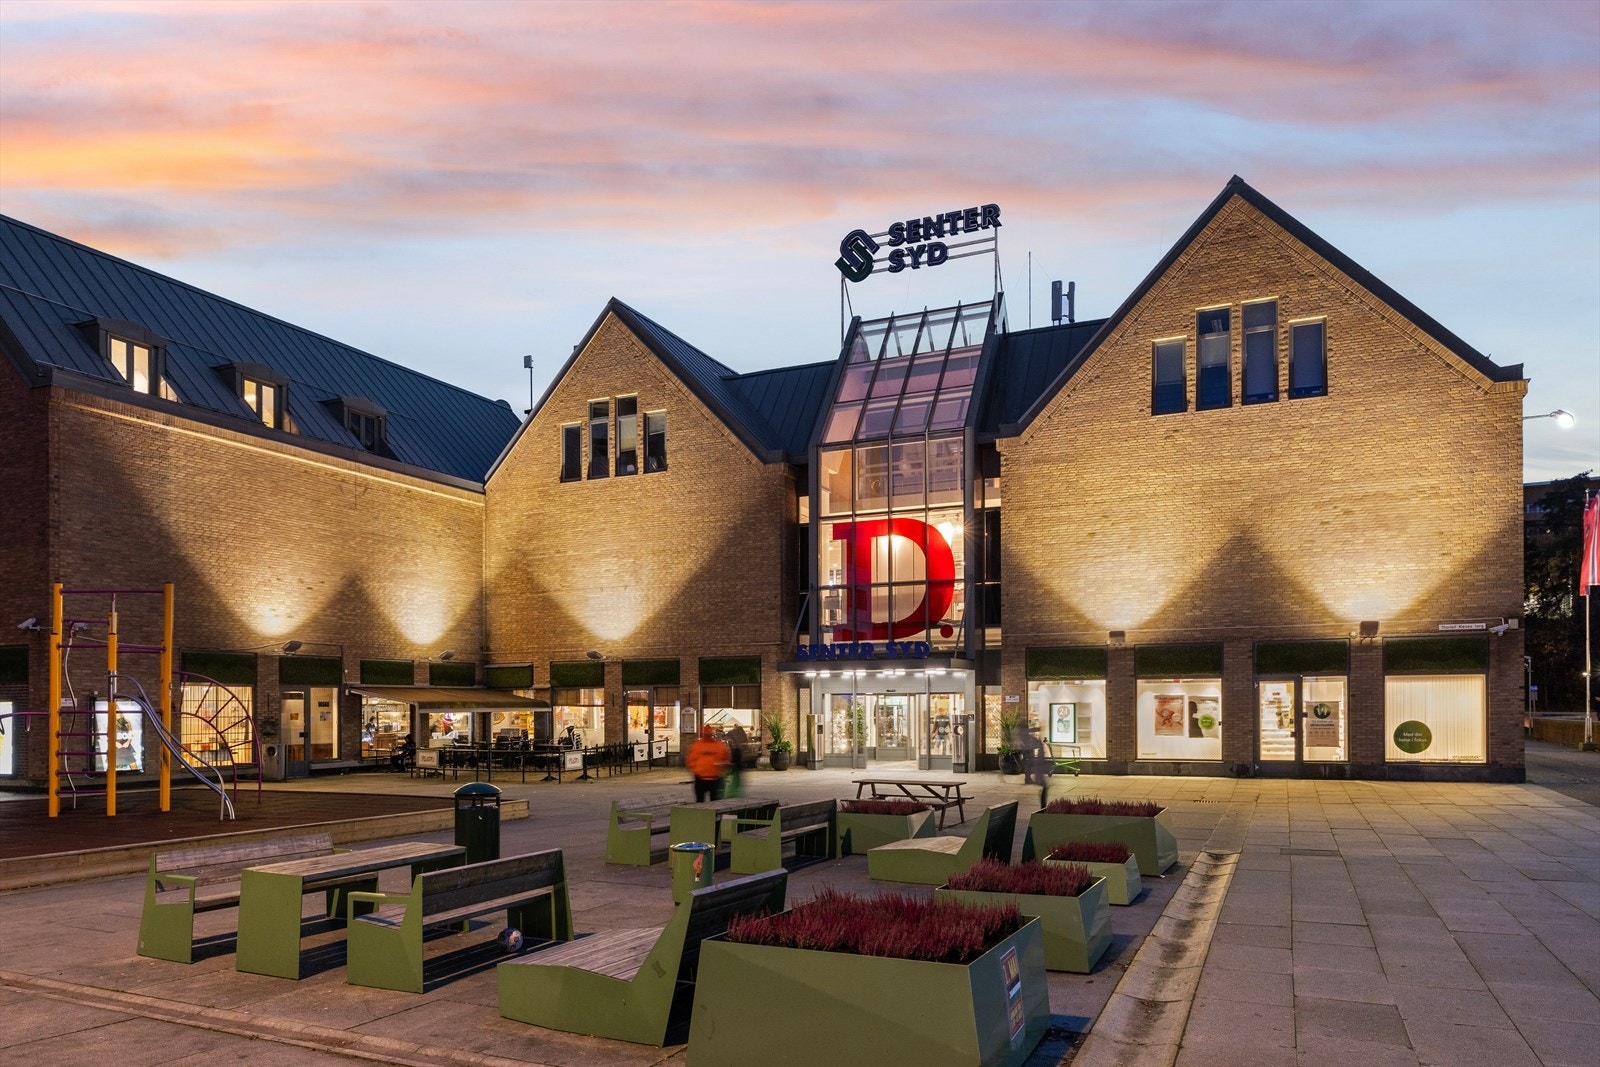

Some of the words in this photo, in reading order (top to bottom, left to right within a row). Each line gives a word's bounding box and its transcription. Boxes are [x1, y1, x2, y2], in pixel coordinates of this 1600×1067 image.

[887, 203, 1002, 247] SENTER
[887, 241, 948, 273] SYD
[797, 642, 875, 660] SENTER
[886, 641, 931, 659] SYD
